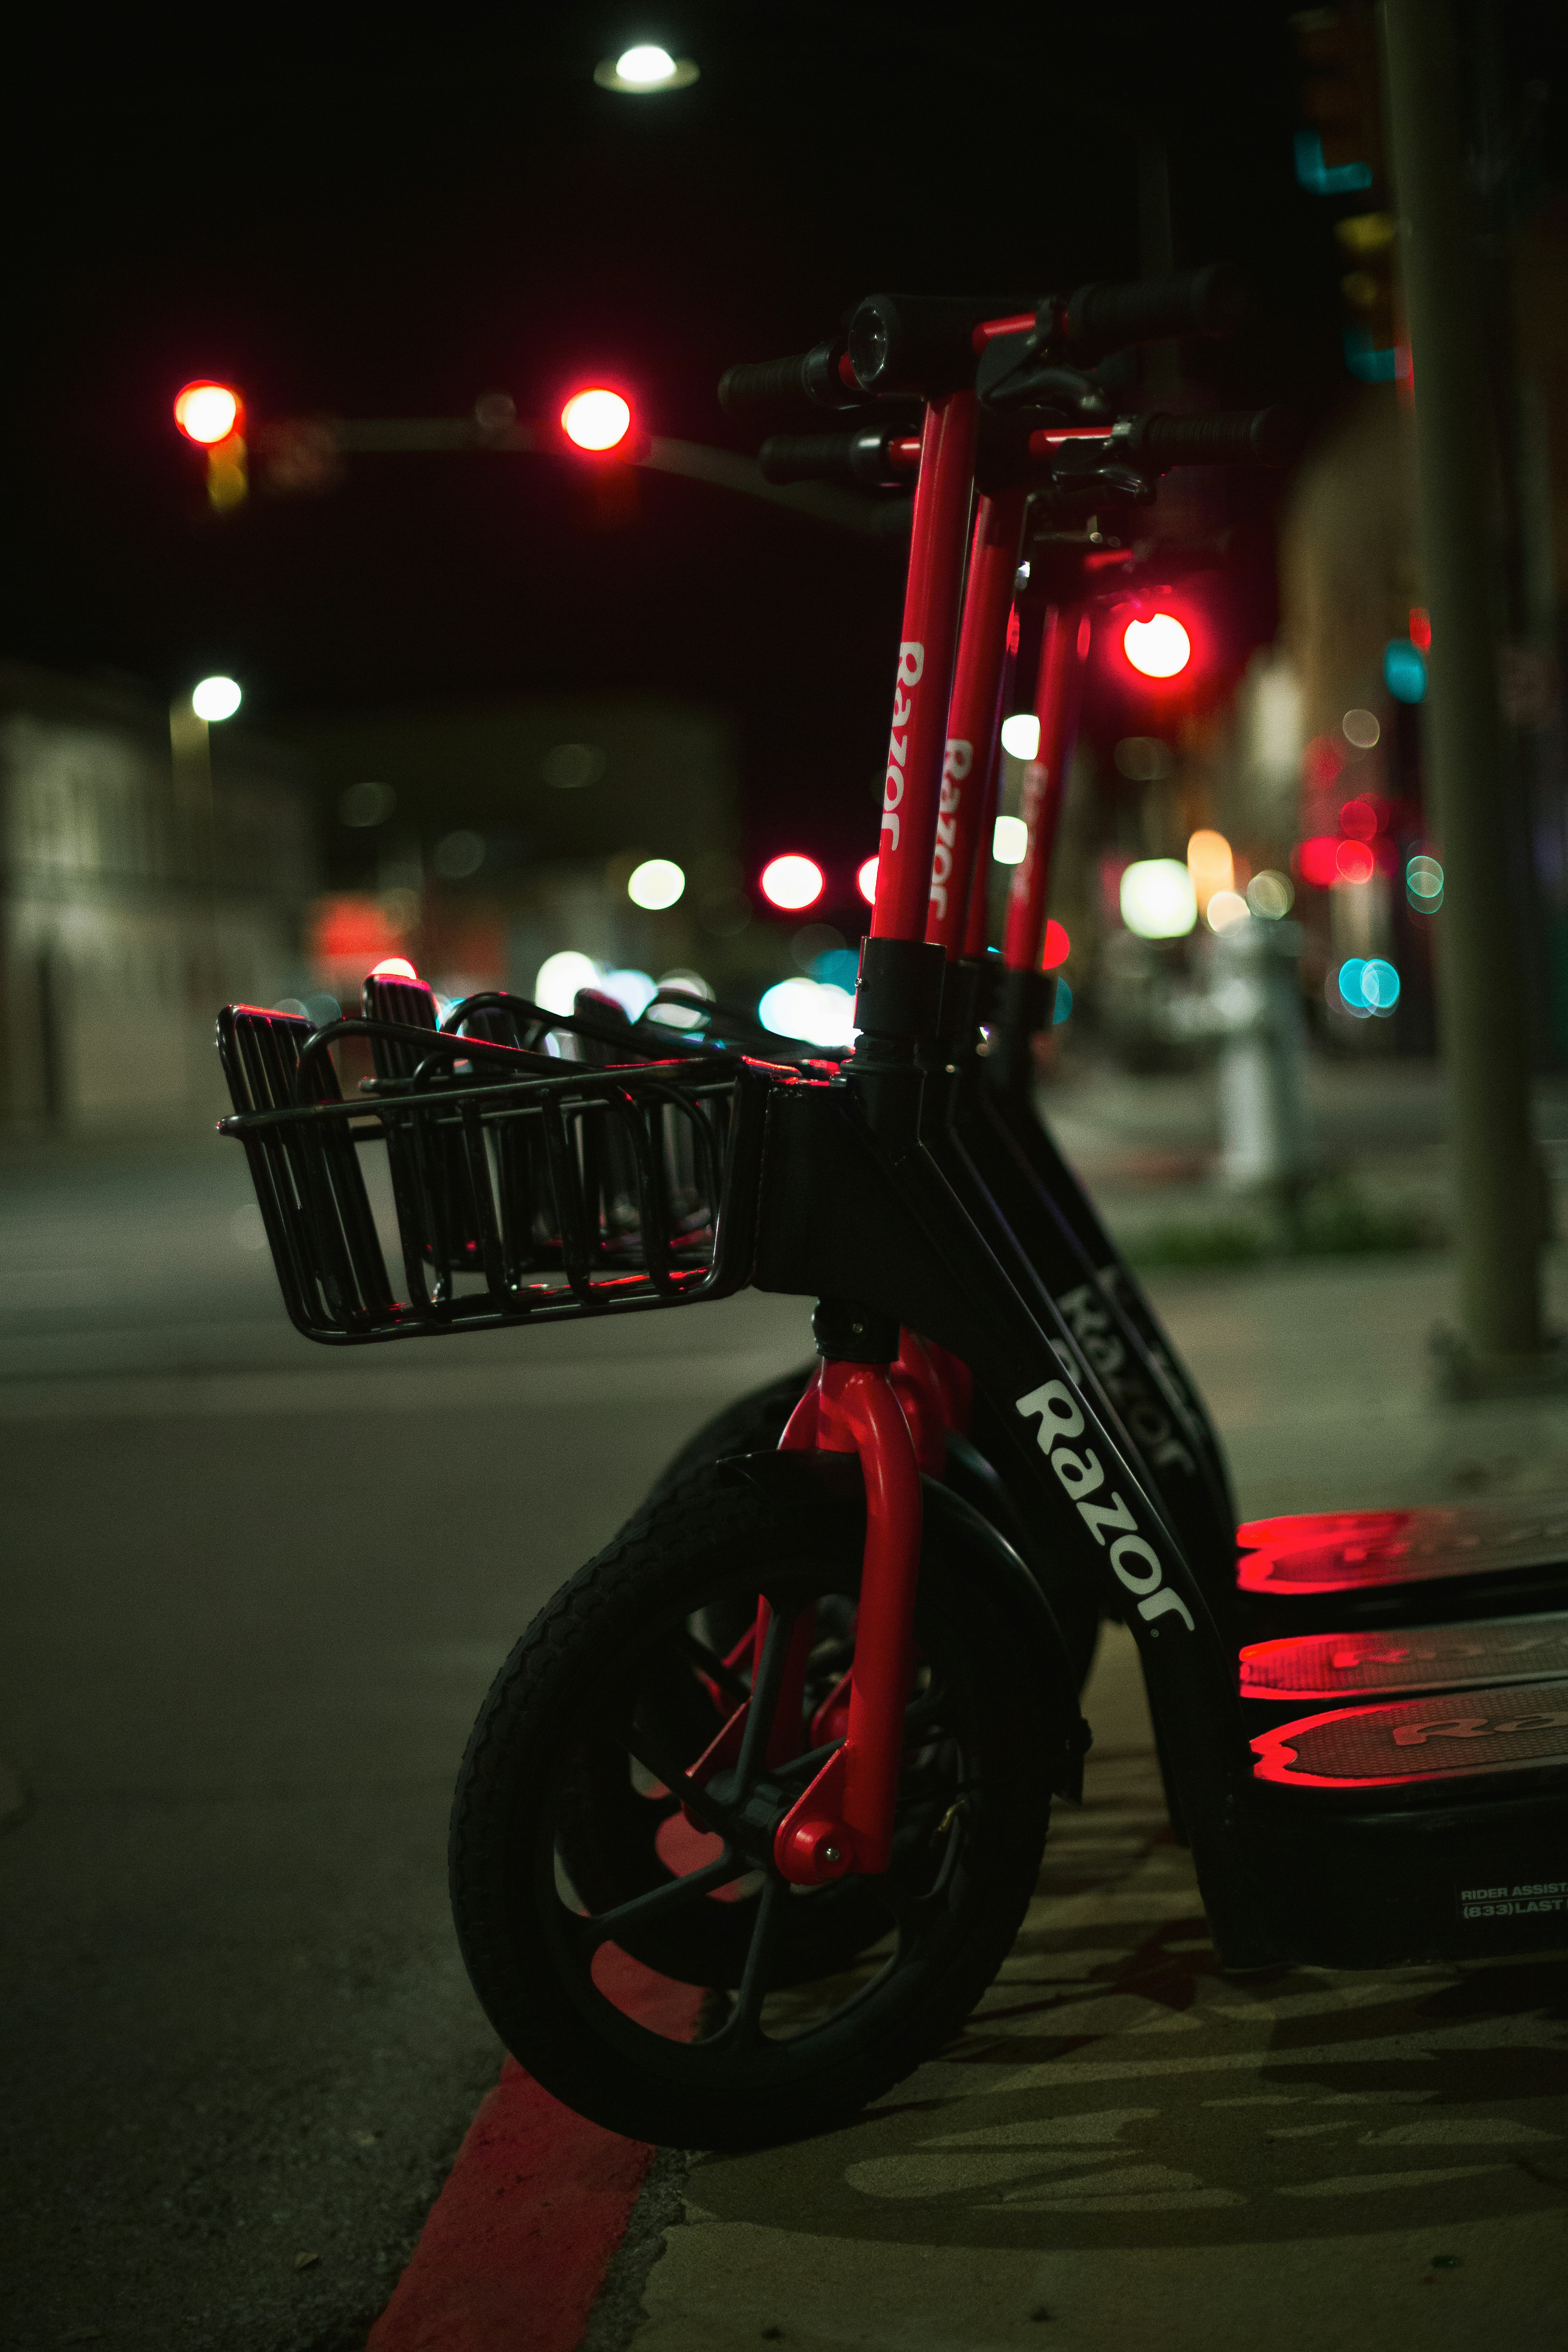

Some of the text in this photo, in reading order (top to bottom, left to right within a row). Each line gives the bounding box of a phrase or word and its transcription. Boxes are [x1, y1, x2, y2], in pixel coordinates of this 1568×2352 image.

[881, 641, 924, 851] Razor
[930, 738, 974, 920] Razor
[1016, 1379, 1195, 1631] Razor
[1461, 1882, 1568, 1900] RIDER ASSIST
